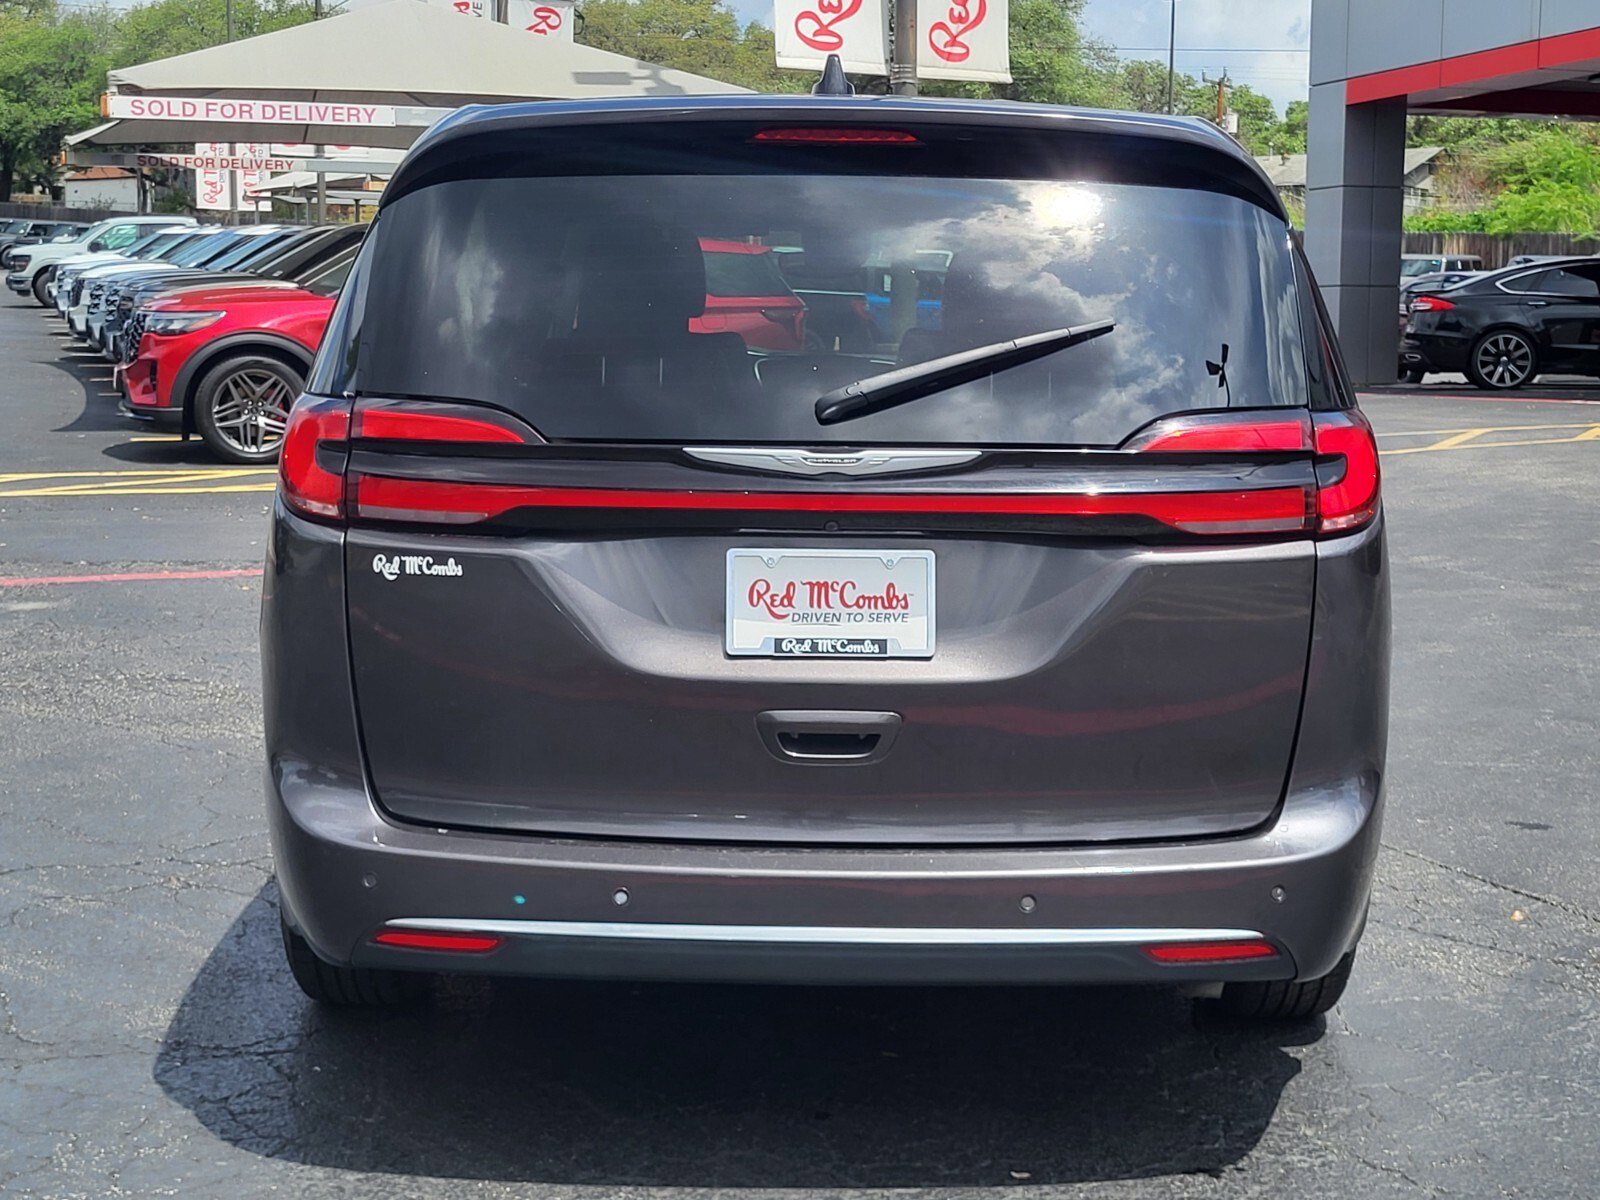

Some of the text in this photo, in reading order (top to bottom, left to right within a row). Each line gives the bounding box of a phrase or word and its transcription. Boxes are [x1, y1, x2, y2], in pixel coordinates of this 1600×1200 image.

[795, 0, 862, 51] Re
[929, 0, 987, 63] Re
[130, 99, 377, 124] SOLD FOR DELIVERY
[137, 155, 294, 170] SOLD FOR DELIVERY
[203, 180, 223, 204] Red
[372, 553, 463, 581] Red McCombs
[748, 578, 796, 620] Red
[791, 612, 909, 623] DRIVEN TO SERVE
[781, 638, 879, 654] Red McCombs
